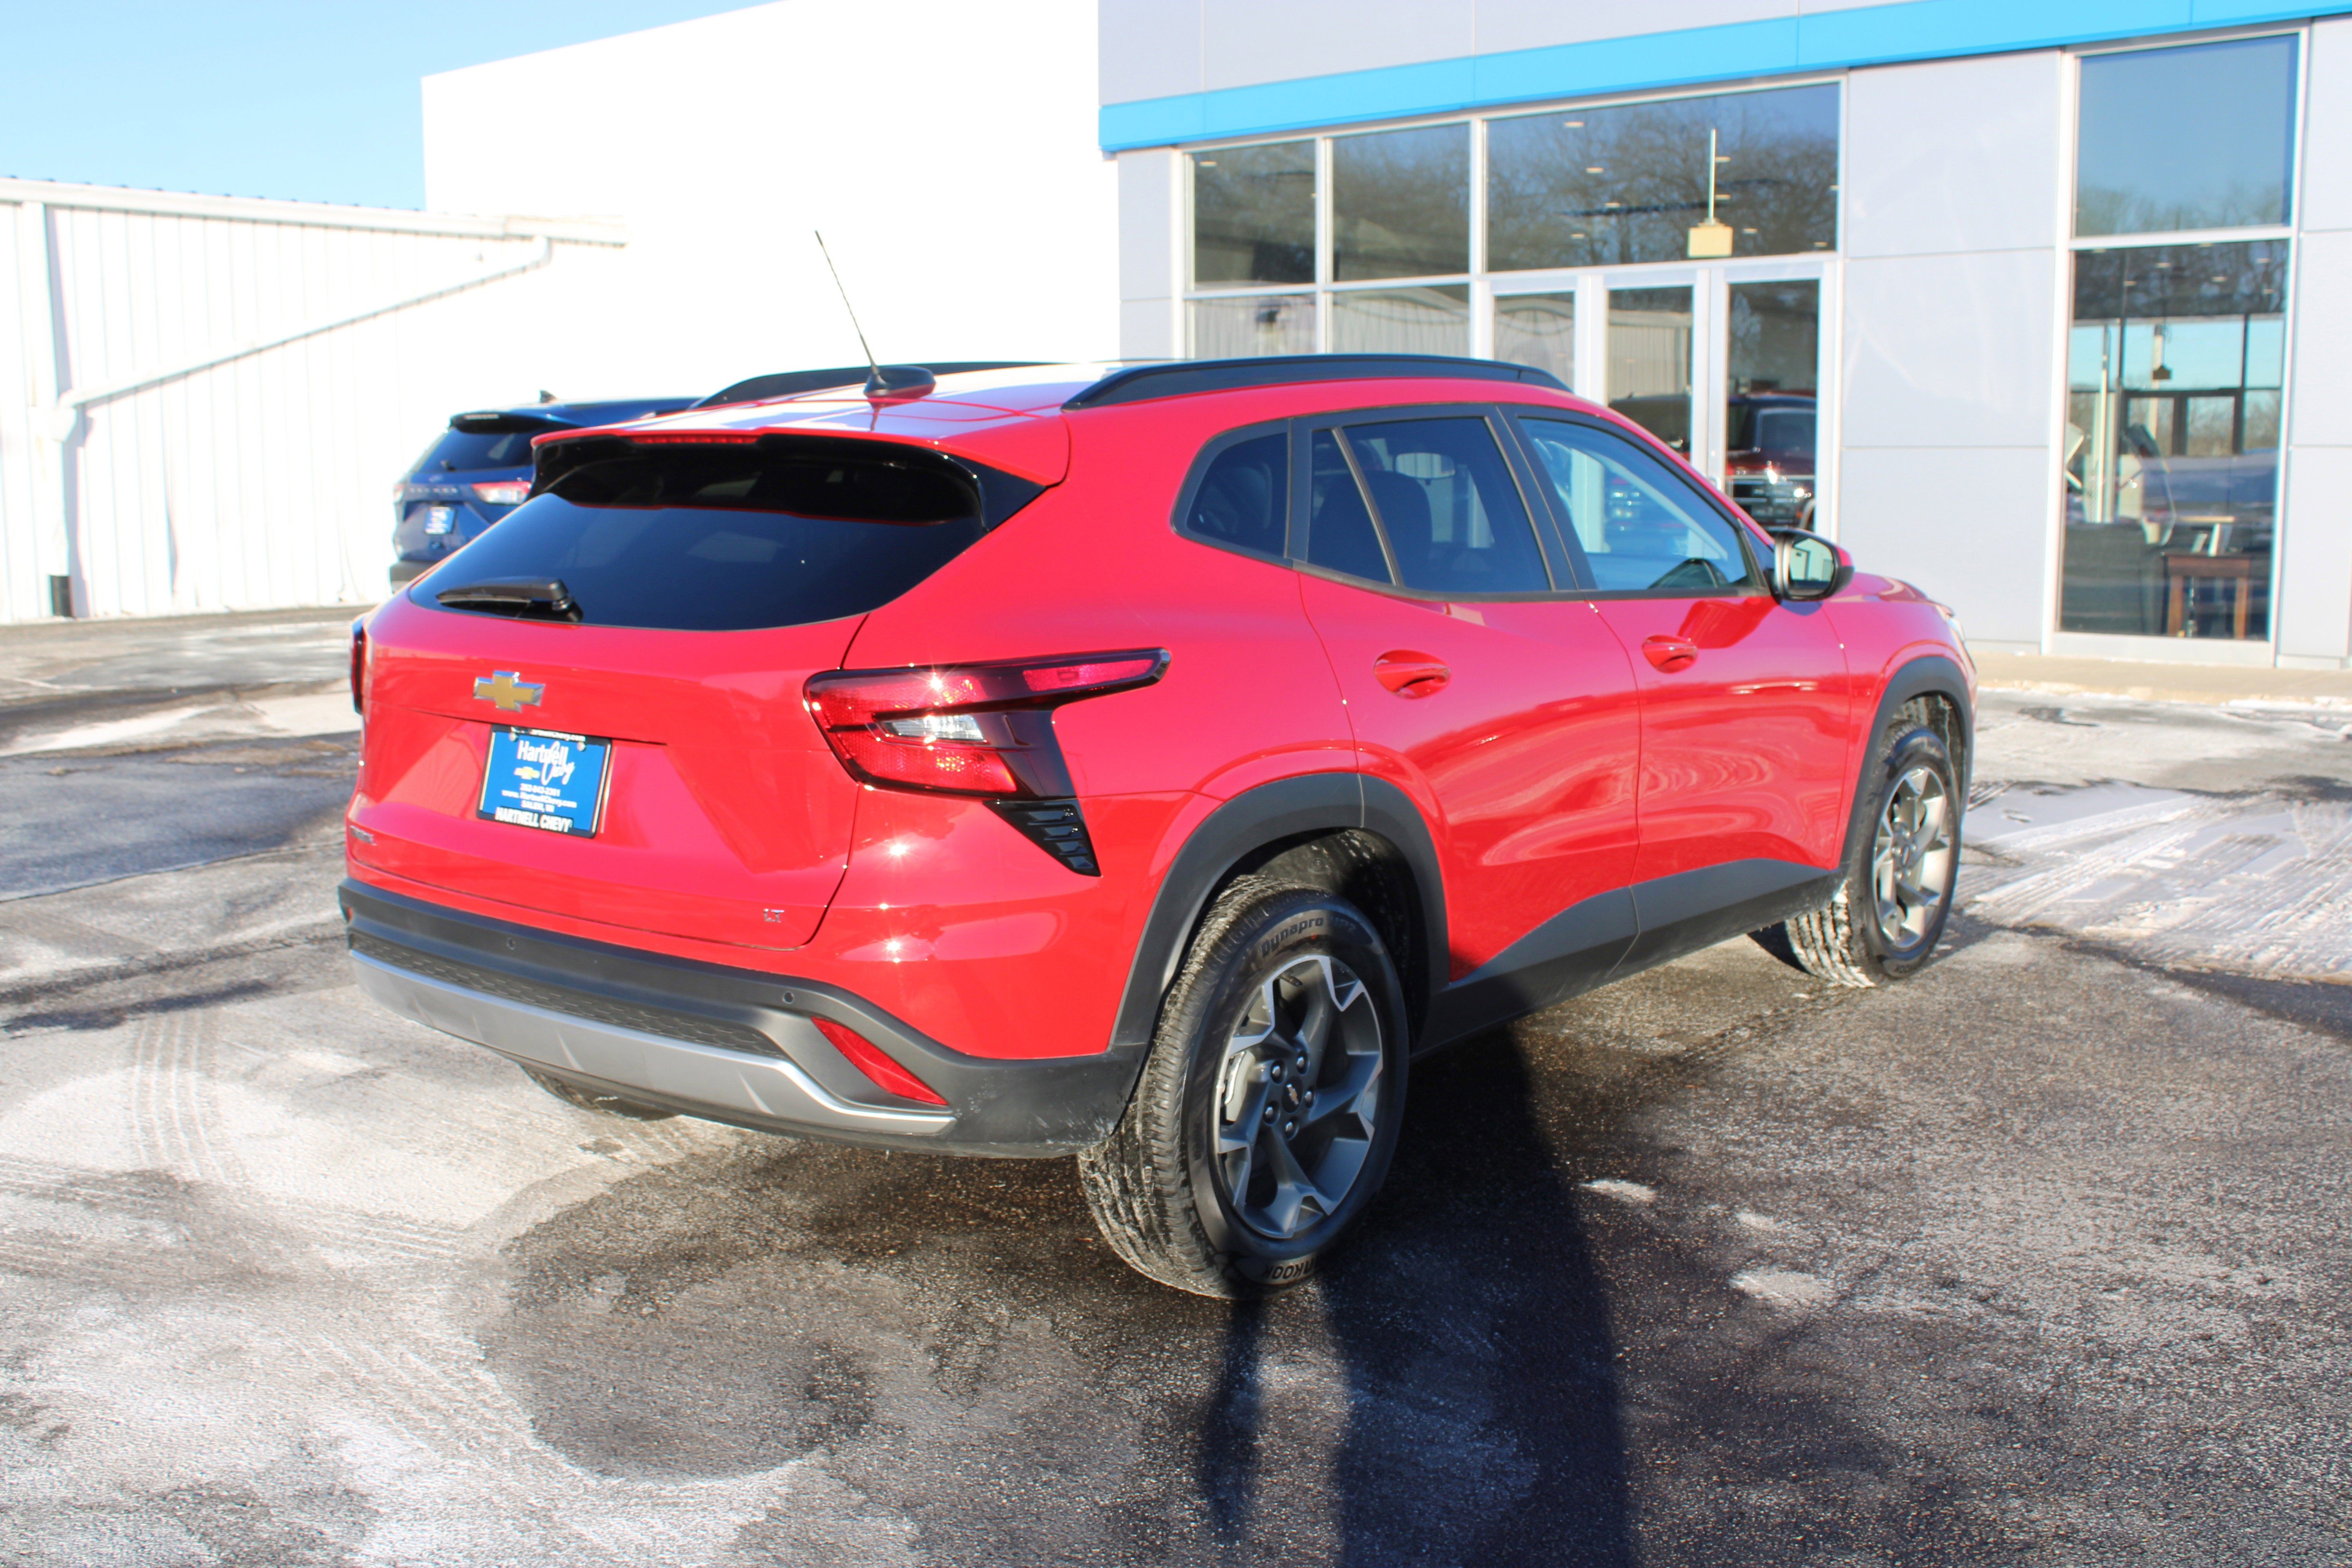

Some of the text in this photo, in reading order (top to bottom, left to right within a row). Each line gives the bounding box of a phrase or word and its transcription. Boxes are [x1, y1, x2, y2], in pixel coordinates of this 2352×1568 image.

[517, 740, 569, 765] Hartnell
[494, 806, 572, 833] HARTNELL CHEVY
[763, 908, 785, 923] LT
[1261, 917, 1324, 958] Dynapro
